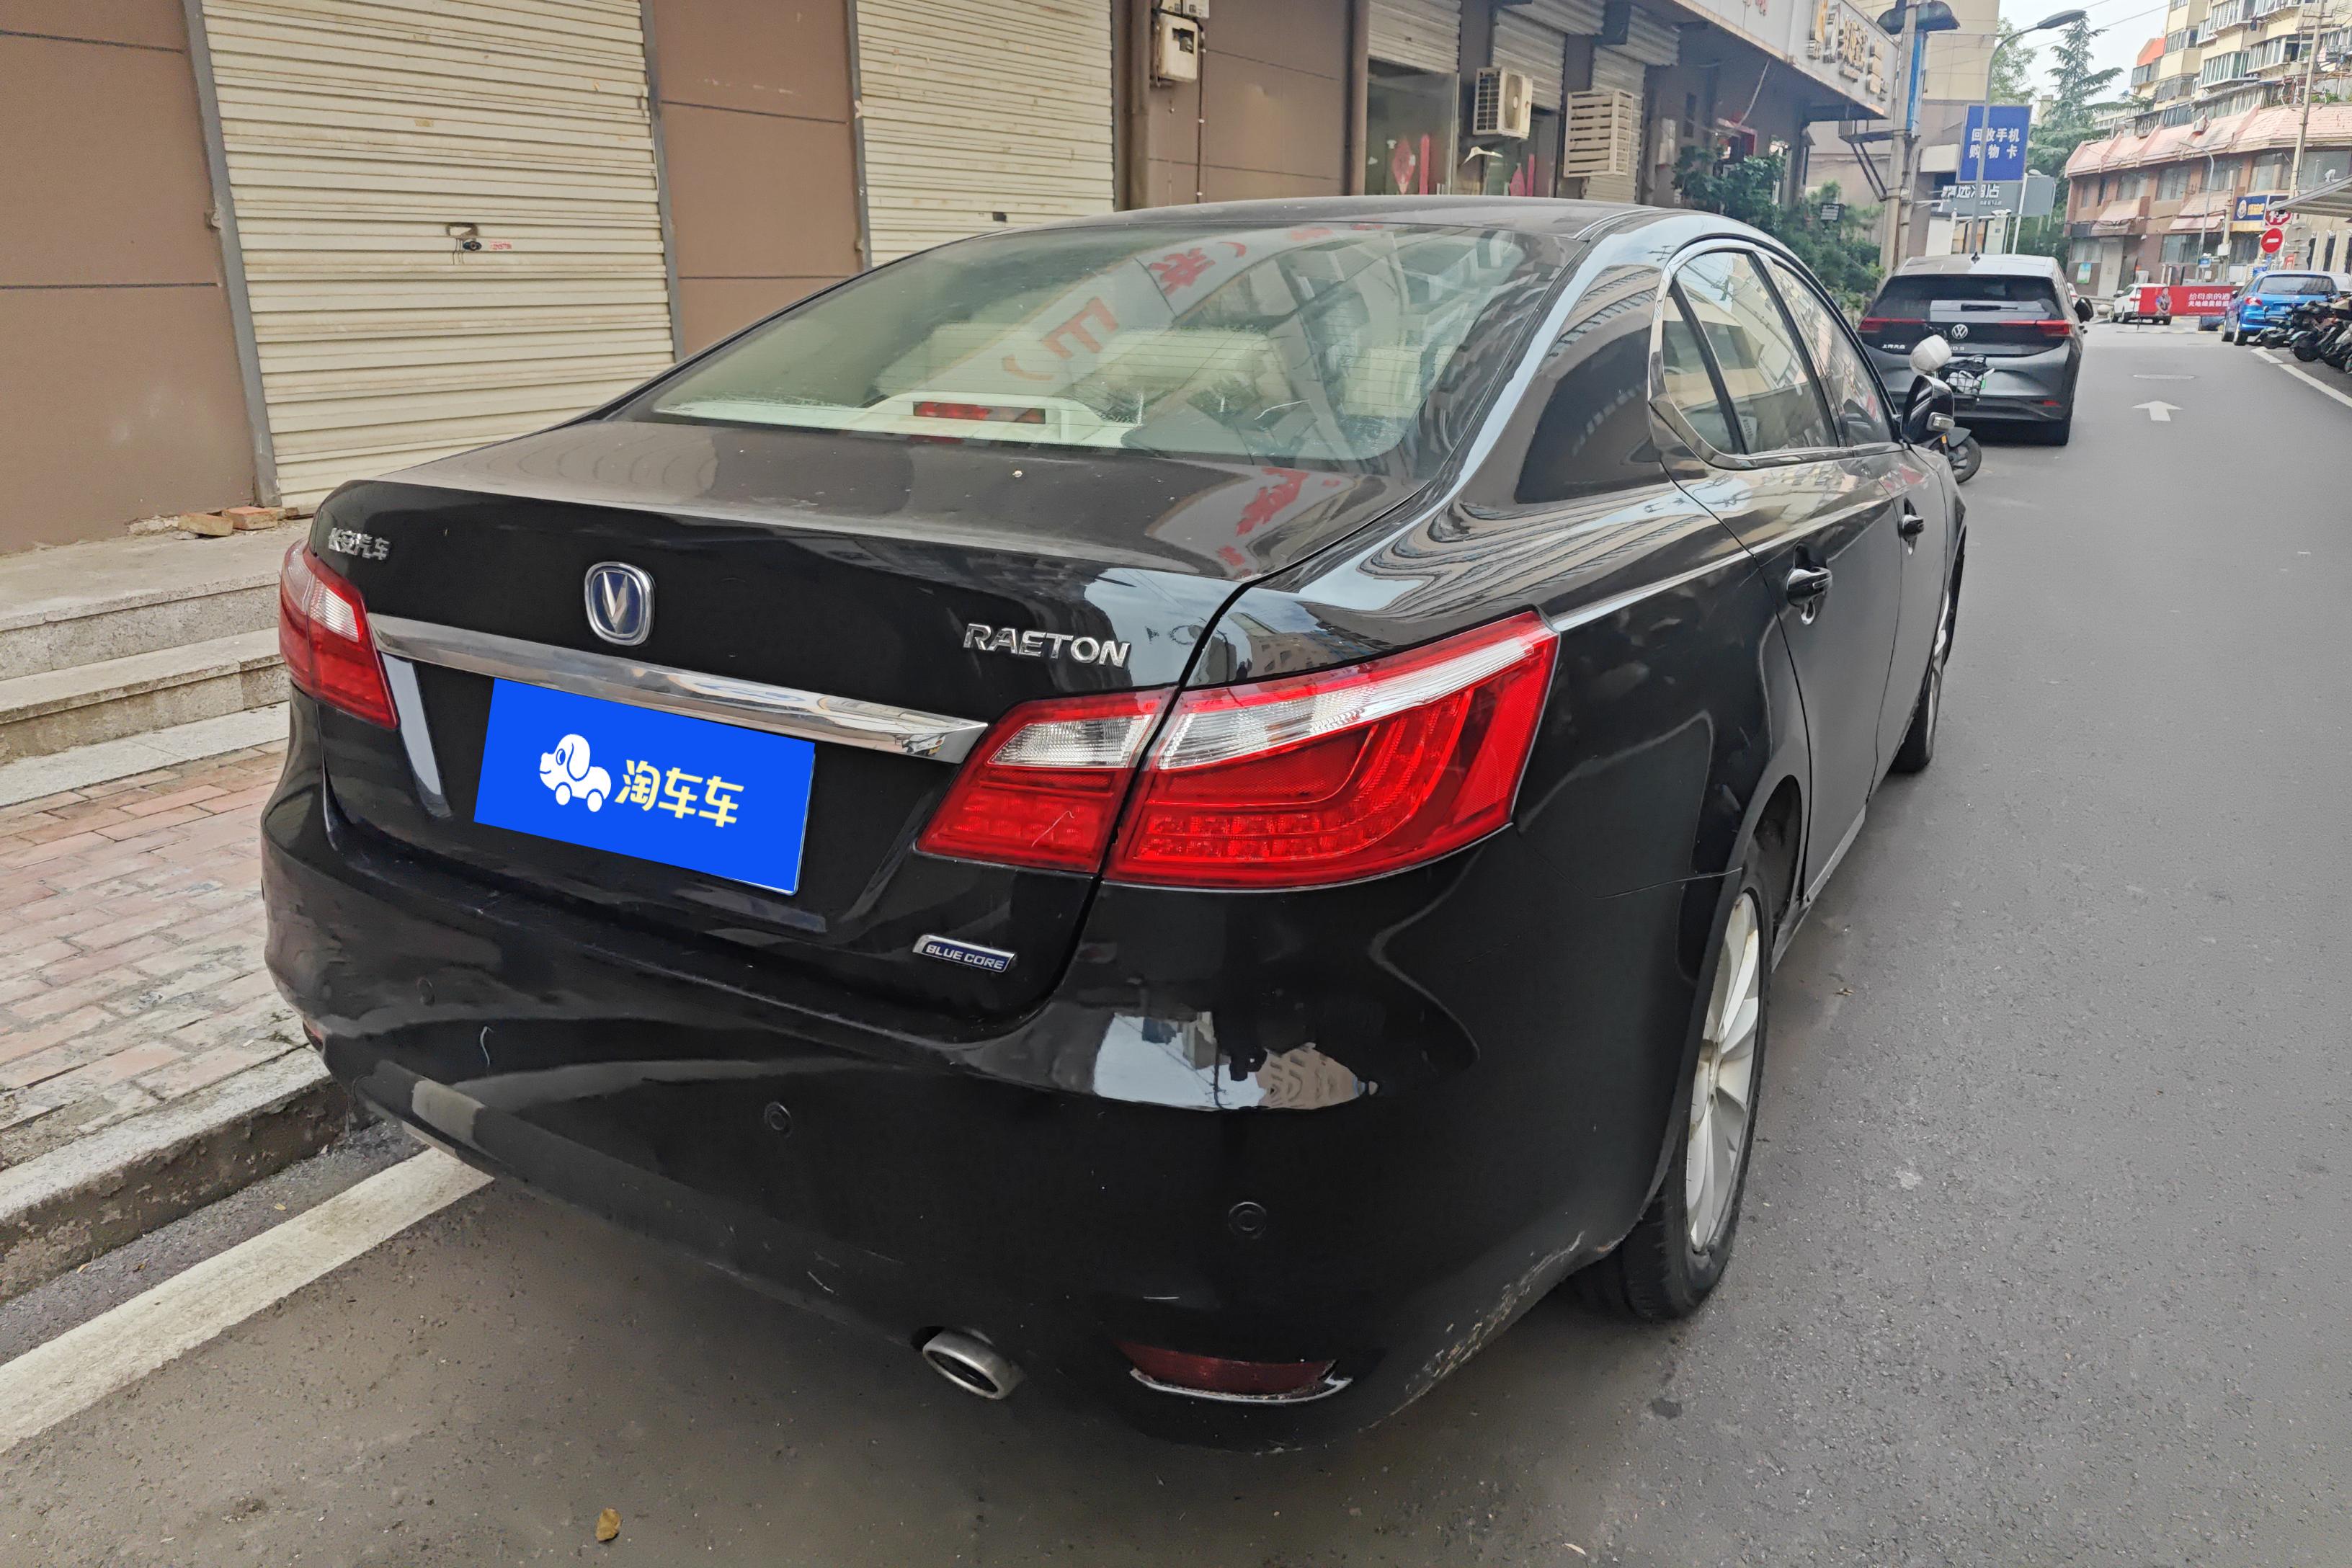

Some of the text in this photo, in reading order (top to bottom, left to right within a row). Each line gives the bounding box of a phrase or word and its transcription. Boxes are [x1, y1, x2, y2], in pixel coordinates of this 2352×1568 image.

[1972, 128, 2020, 142] 回收手机
[1969, 144, 2018, 159] 购物卡
[329, 527, 389, 561] 长安汽车
[963, 623, 1131, 669] RAETON
[926, 944, 1004, 969] BLUE CORE
